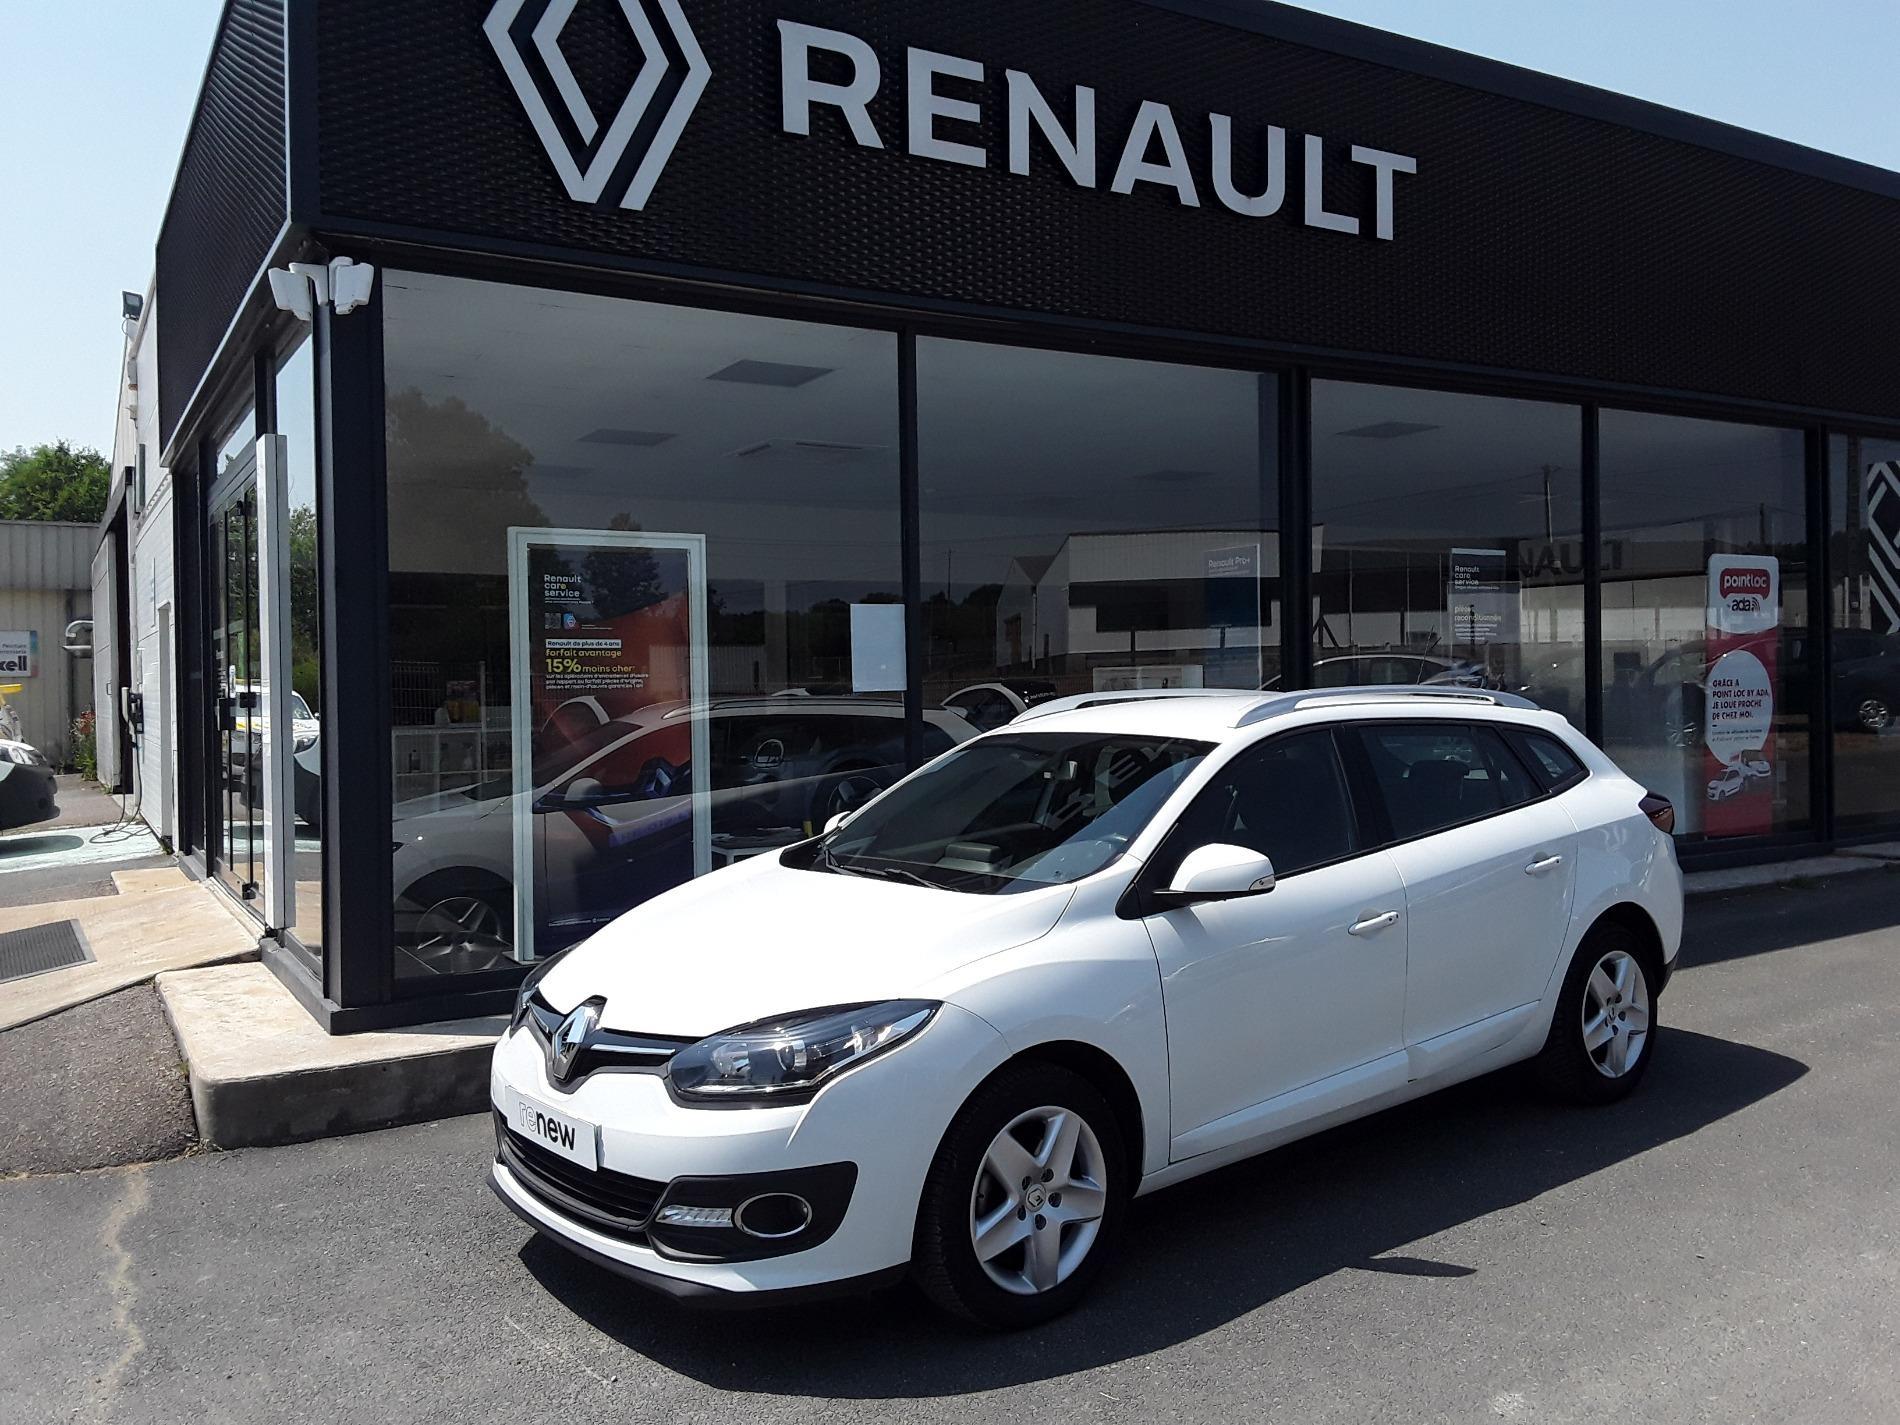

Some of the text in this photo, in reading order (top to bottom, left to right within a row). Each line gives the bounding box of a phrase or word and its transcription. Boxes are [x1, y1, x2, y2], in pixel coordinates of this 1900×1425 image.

[777, 19, 1417, 240] RENAULT
[1454, 565, 1480, 573] Renault
[544, 574, 581, 583] Renault
[544, 589, 580, 597] service
[1731, 598, 1751, 611] ada
[545, 649, 577, 657] forfait
[545, 659, 582, 673] 15%
[582, 665, 611, 673] moins
[1712, 690, 1732, 698] POINT
[1733, 689, 1745, 698] LOC
[1747, 689, 1755, 697] BY
[1712, 699, 1762, 709] JE LOUE PROCHE
[1712, 712, 1720, 720] DE
[519, 1101, 576, 1151] renew
